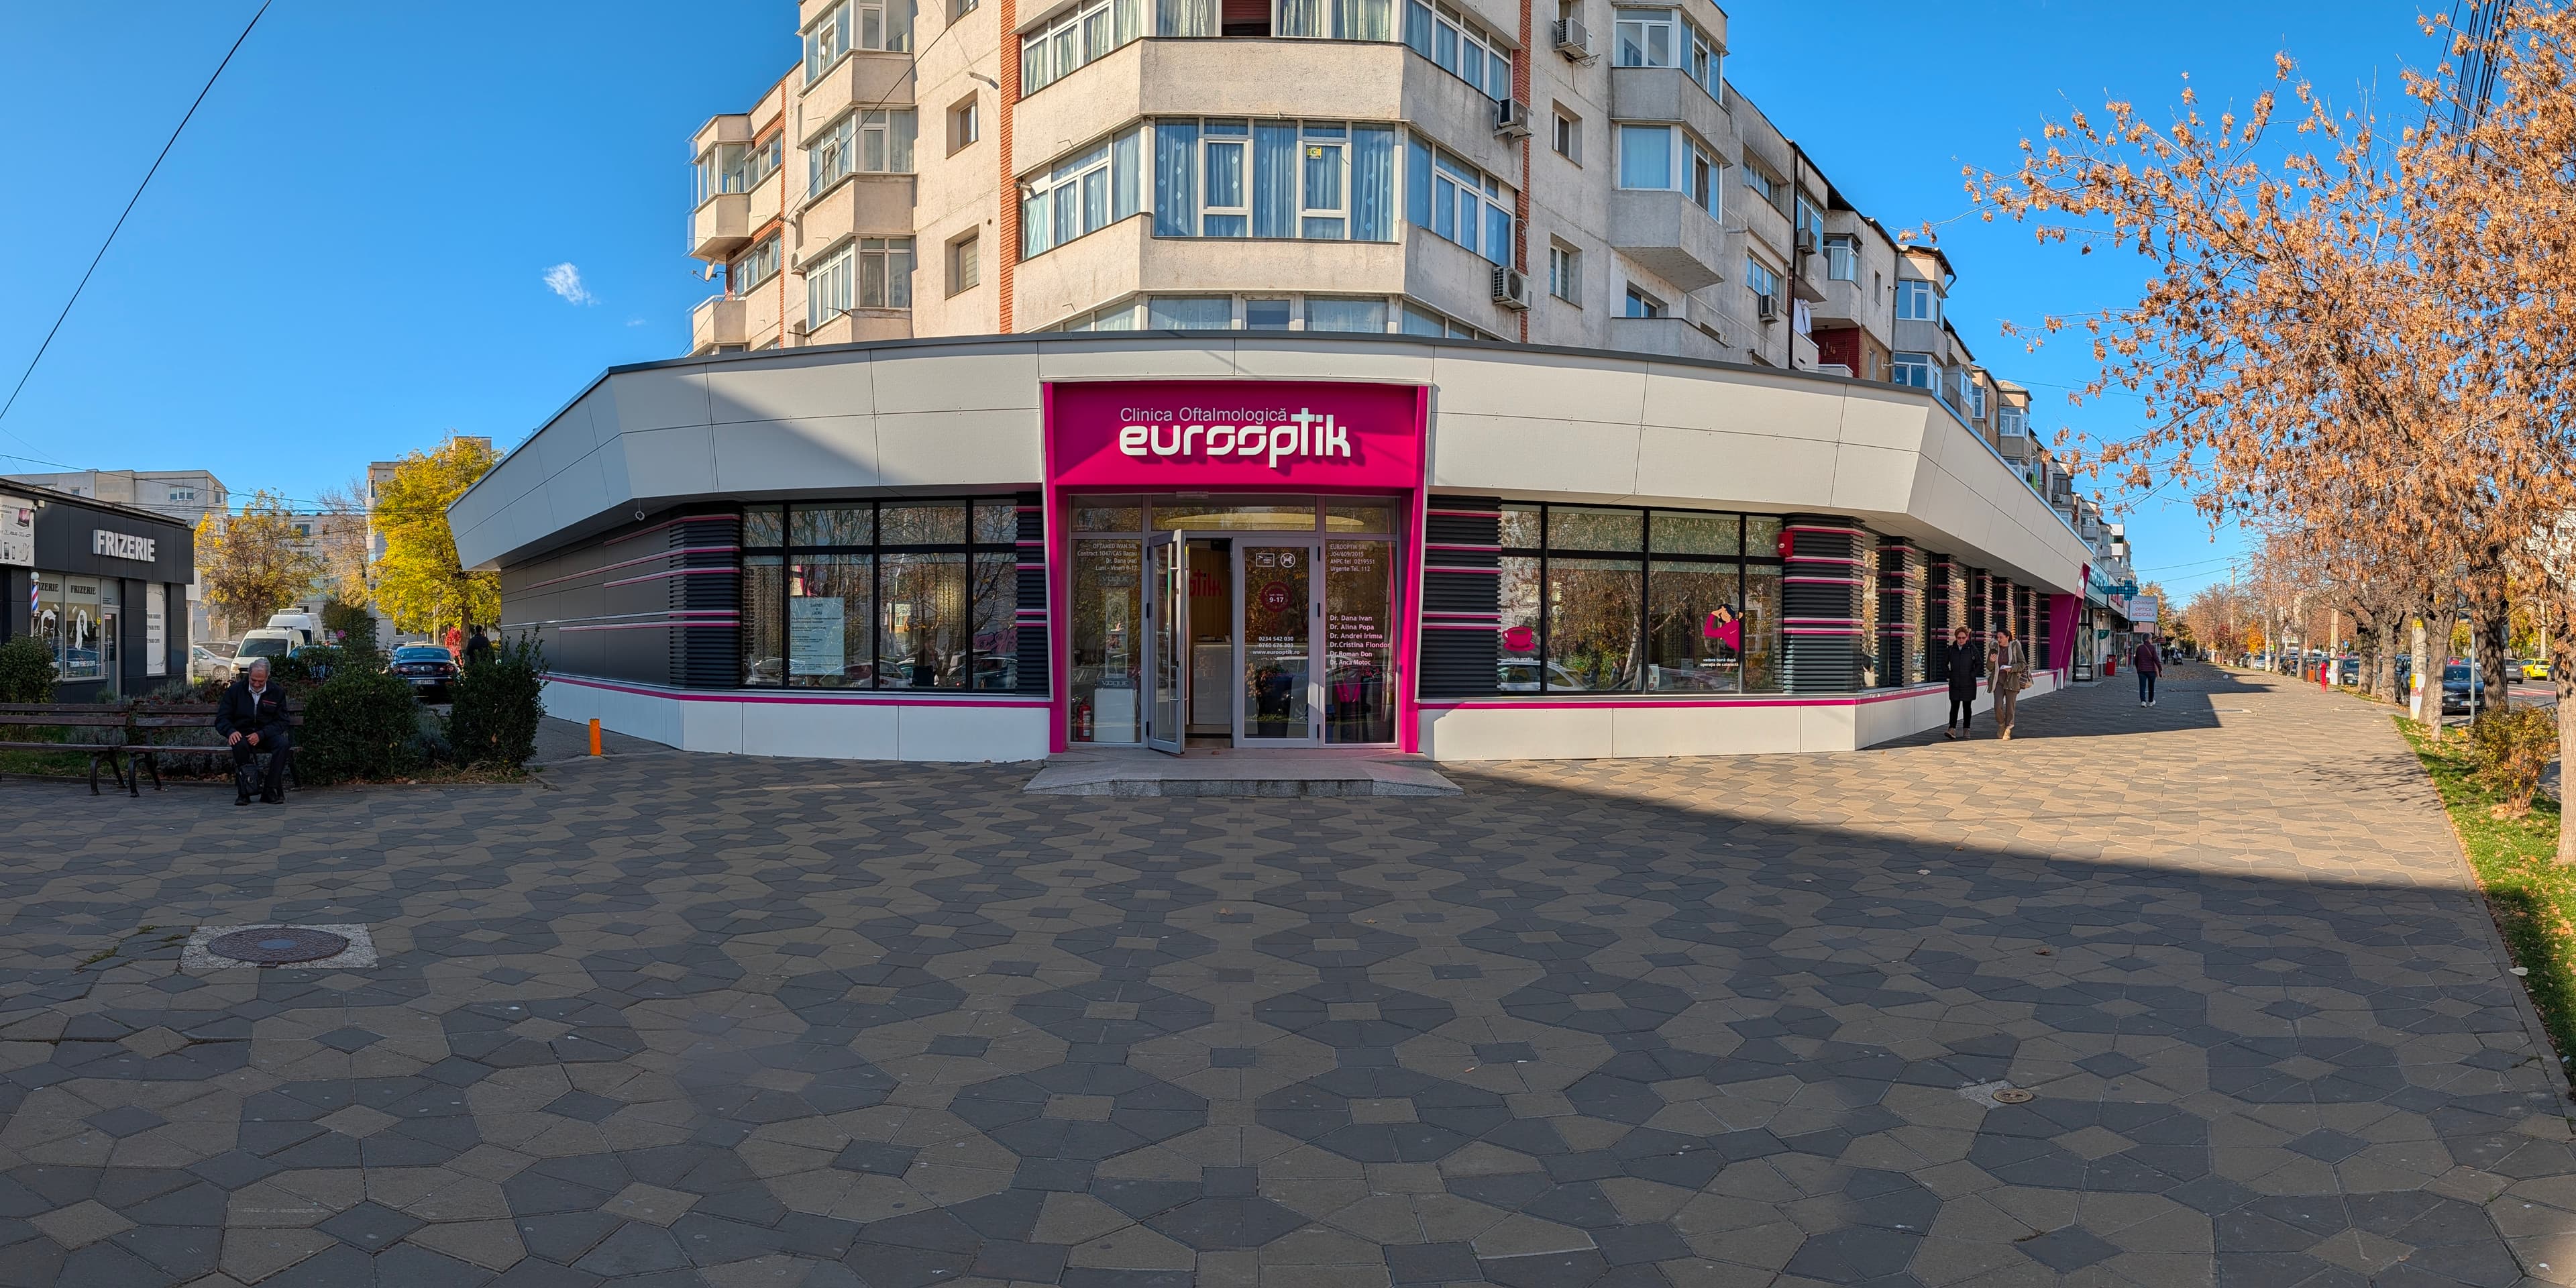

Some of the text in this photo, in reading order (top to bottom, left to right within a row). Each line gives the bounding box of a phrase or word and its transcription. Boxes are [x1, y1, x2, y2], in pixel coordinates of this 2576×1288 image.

[1120, 407, 1287, 425] Clinica Oftalmologică
[1119, 407, 1351, 468] eurooptik
[94, 529, 156, 562] FRIZERIE
[39, 582, 59, 592] IZERIE
[70, 585, 96, 595] FRIZERIE
